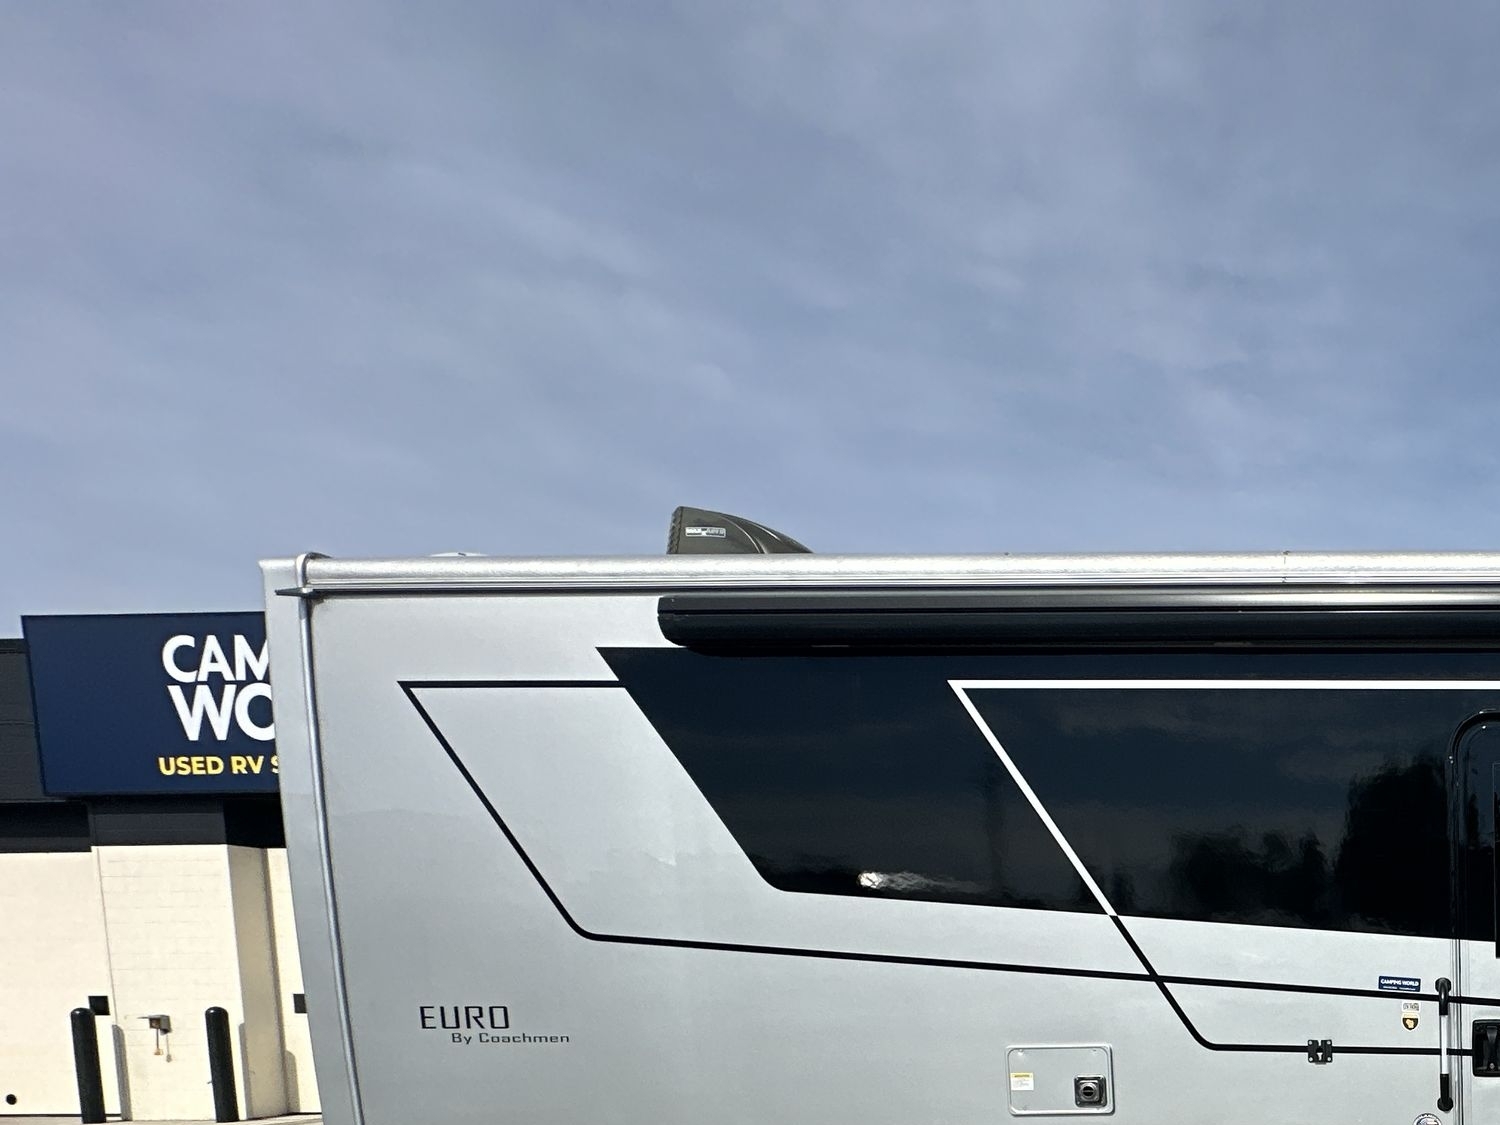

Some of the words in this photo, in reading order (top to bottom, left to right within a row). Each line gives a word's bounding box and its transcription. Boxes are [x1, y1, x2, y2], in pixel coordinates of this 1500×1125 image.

[158, 756, 224, 776] USED
[230, 755, 264, 774] RV
[419, 1006, 509, 1029] EURO
[452, 1032, 472, 1045] By
[479, 1032, 570, 1043] Coachmen
